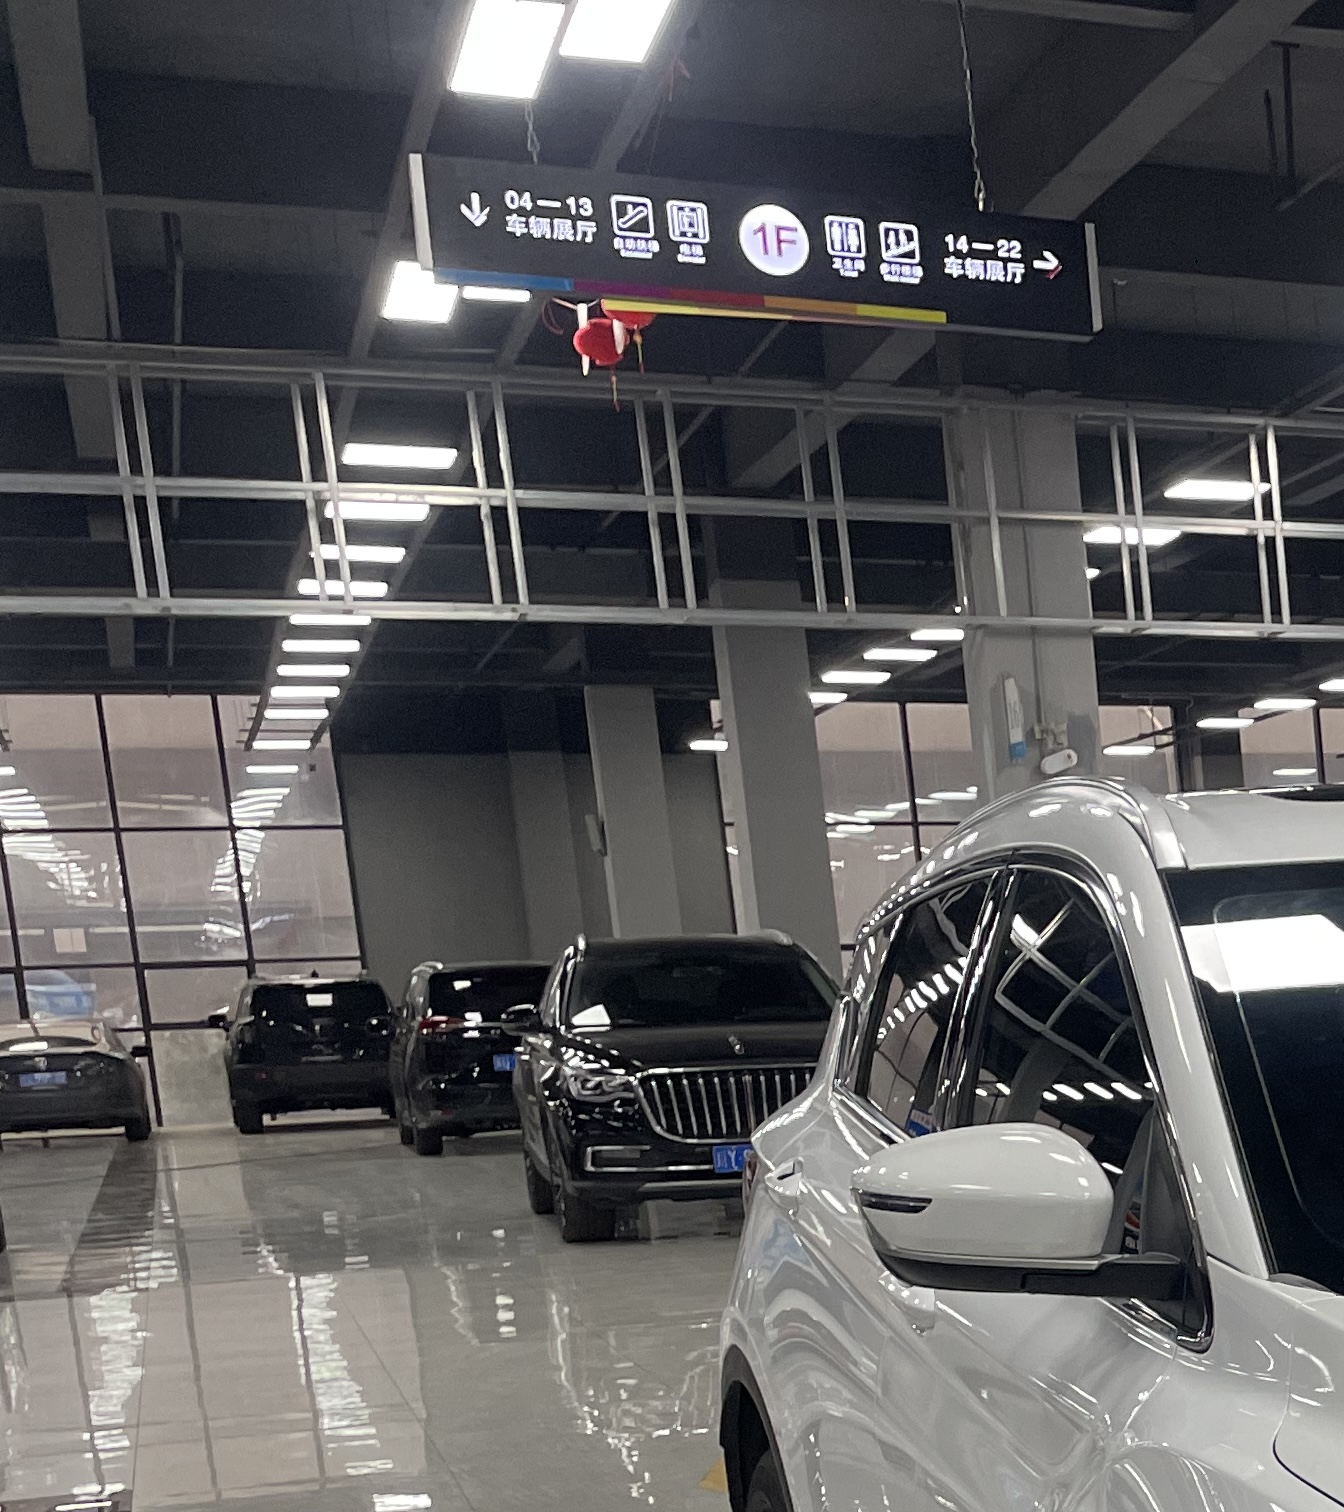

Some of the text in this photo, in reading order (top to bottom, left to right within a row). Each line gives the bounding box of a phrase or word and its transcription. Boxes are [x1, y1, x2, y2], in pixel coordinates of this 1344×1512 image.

[505, 213, 598, 243] 车辆展厅
[753, 221, 798, 257] 1F
[943, 254, 1026, 284] 车辆展厅
